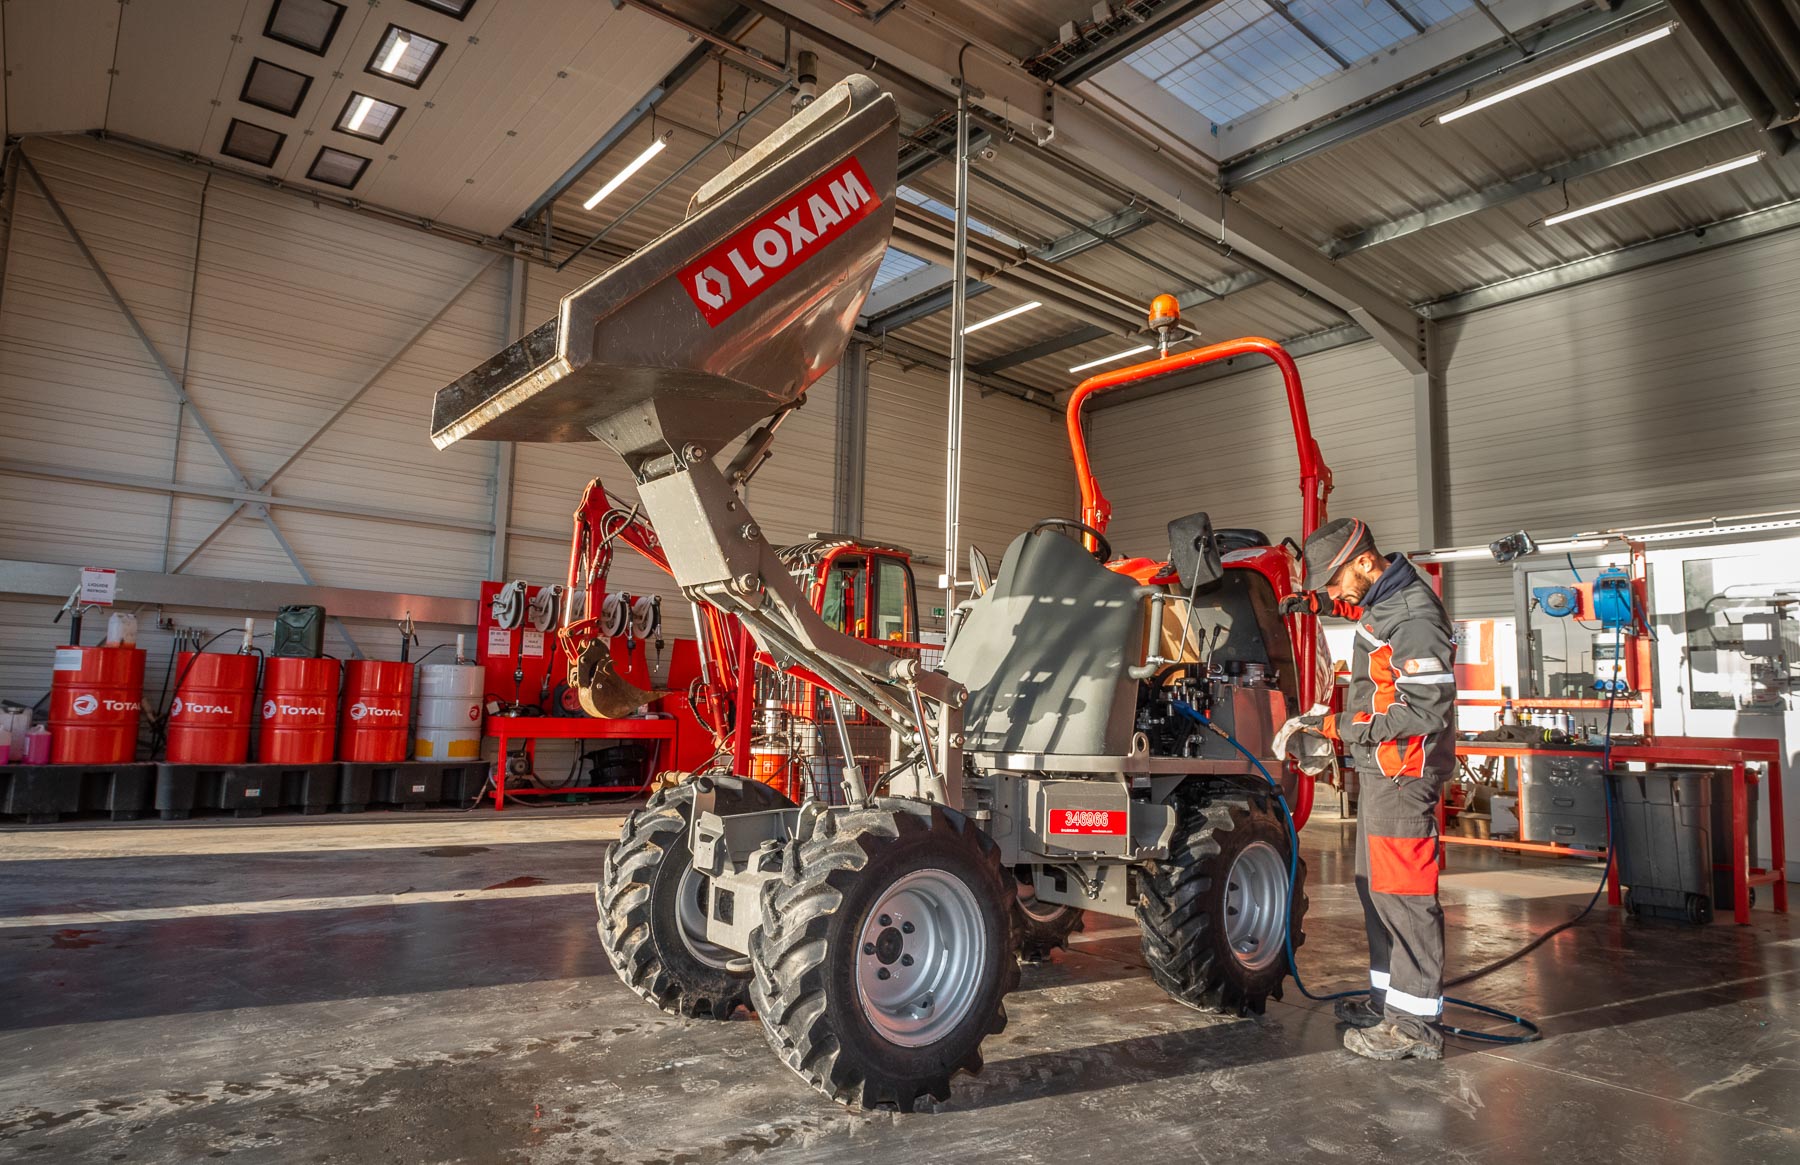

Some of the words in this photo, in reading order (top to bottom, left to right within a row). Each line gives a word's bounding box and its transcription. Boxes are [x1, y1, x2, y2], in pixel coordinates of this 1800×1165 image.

[727, 170, 871, 288] LOXAM
[185, 702, 233, 714] TOTAL
[280, 705, 325, 716] TOTAL
[367, 706, 403, 717] TOTAL
